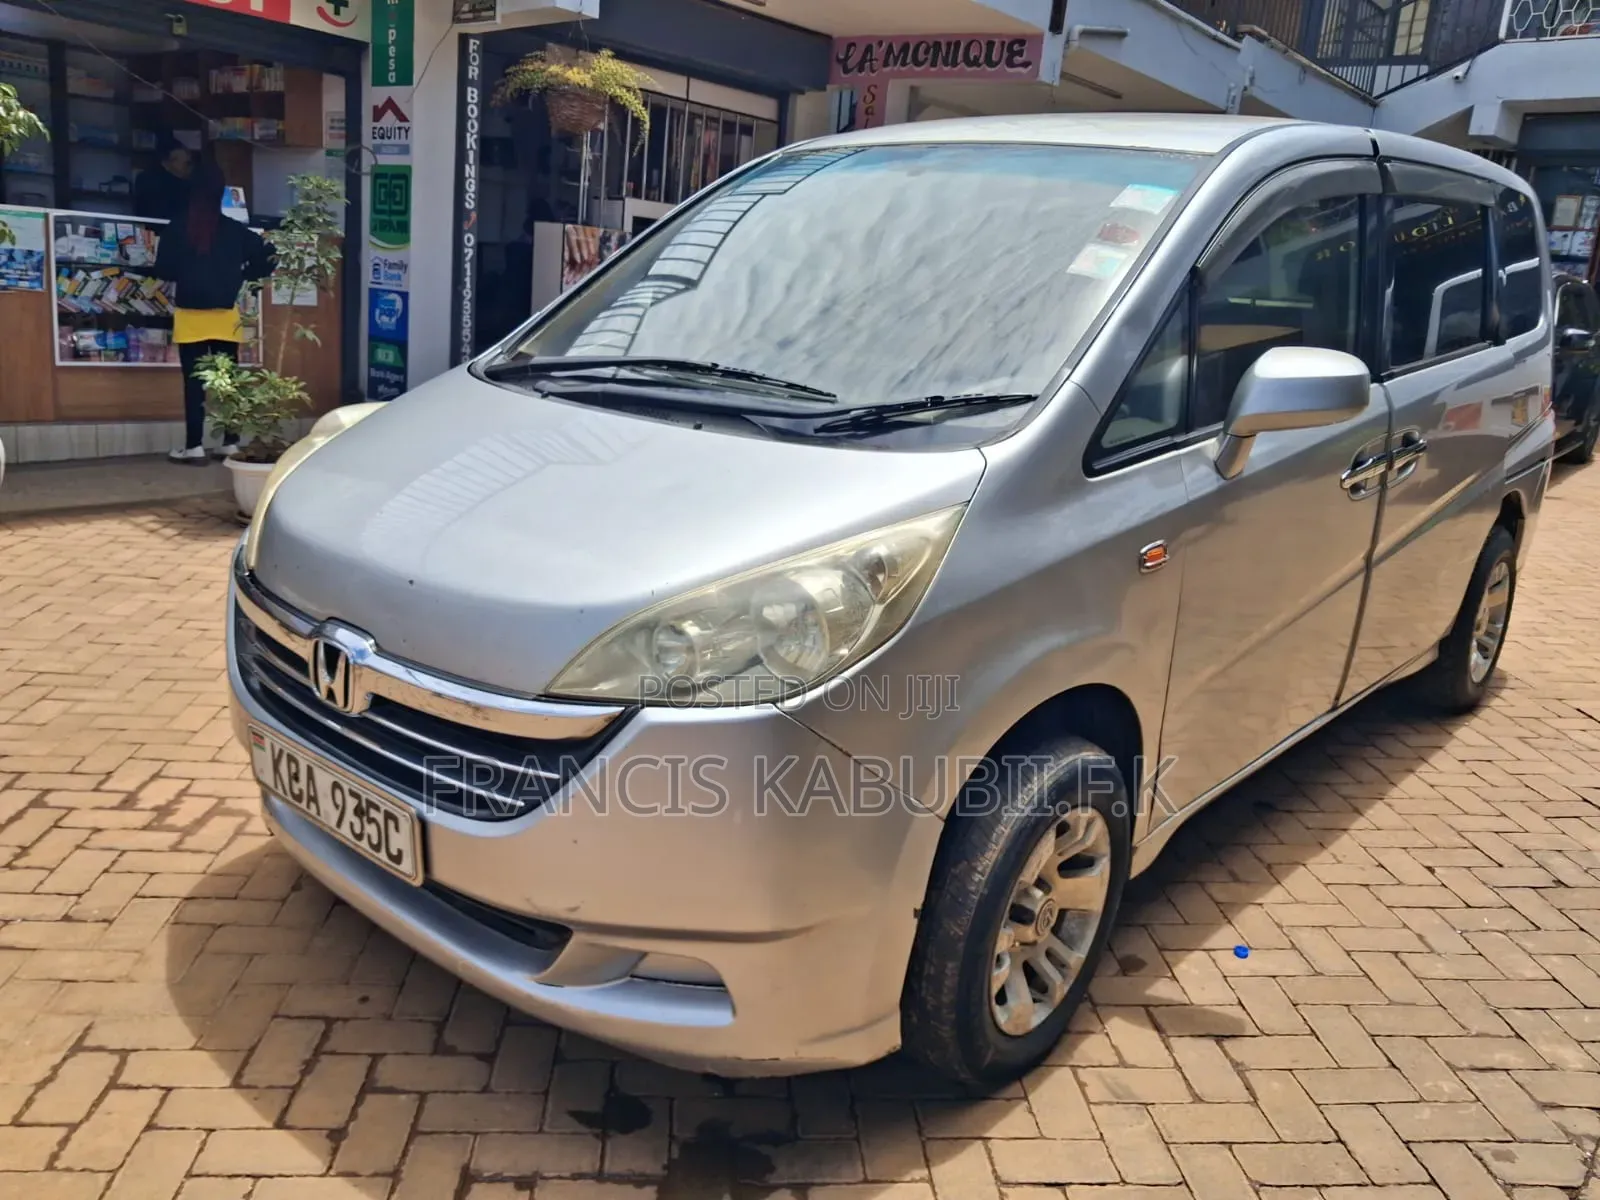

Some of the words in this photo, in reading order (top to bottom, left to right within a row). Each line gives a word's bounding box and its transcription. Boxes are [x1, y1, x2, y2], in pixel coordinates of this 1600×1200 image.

[468, 38, 480, 81] FOR
[836, 38, 1033, 76] LA'MONIQUE
[372, 126, 411, 141] EQUITY
[464, 86, 479, 210] BOOKINGS
[383, 258, 409, 274] Family
[270, 742, 321, 817] KBA
[331, 780, 404, 866] 935C
